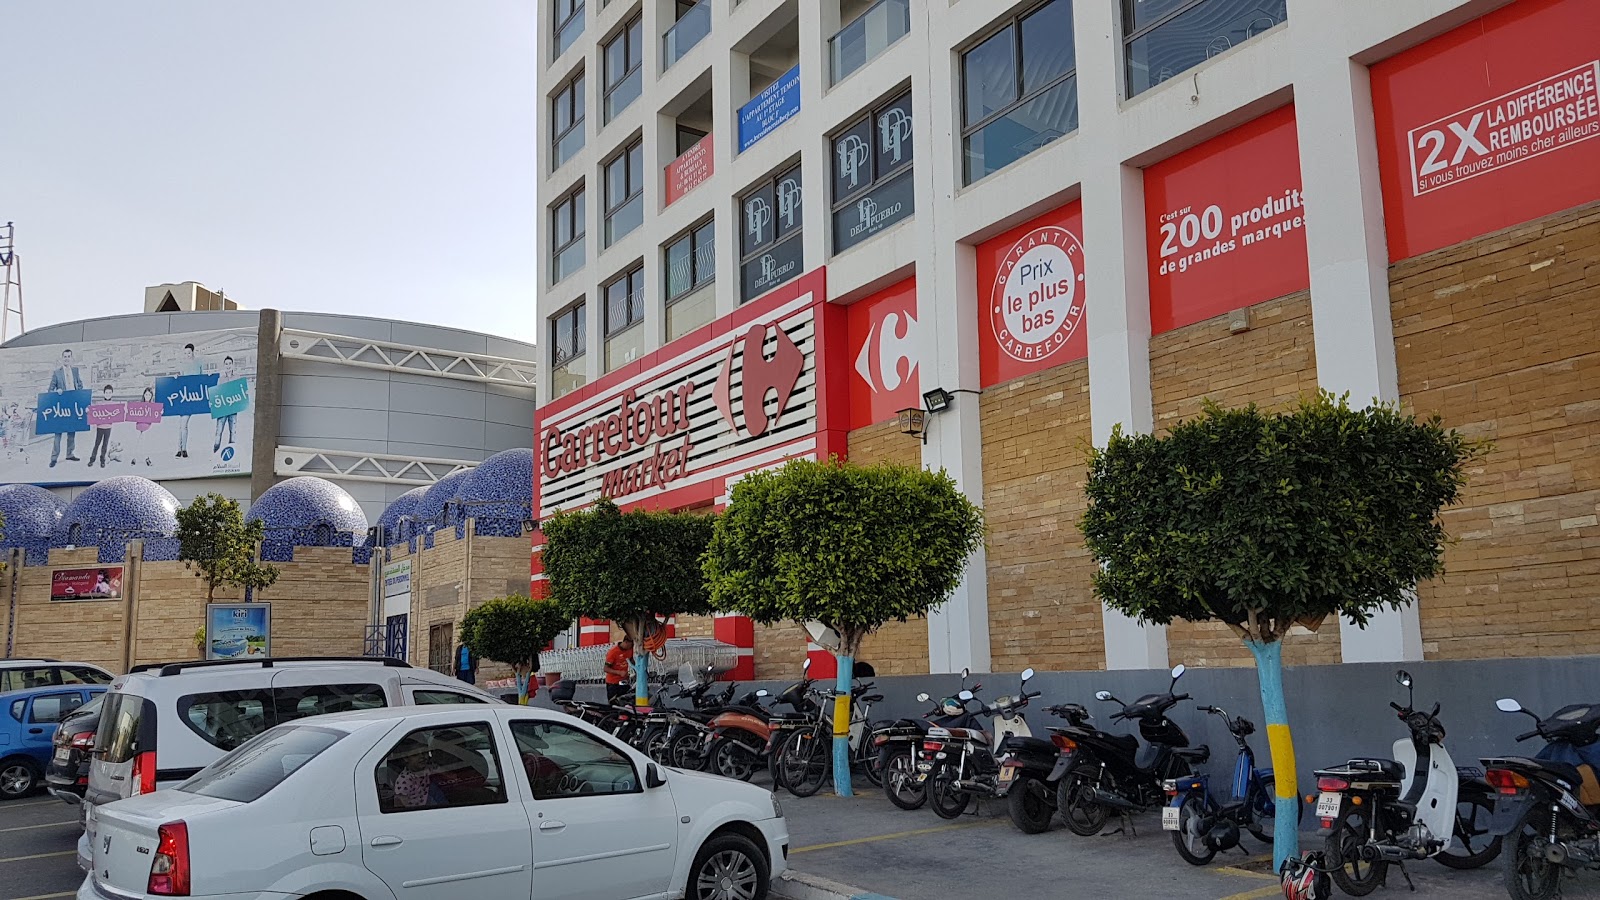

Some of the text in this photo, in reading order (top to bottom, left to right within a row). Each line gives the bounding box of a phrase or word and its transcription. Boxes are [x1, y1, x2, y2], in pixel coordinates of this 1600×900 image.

[742, 75, 800, 124] L'APPARTEMENT TEMOIN
[760, 81, 780, 100] VISITEZ
[769, 96, 785, 114] ETAGE
[1487, 69, 1594, 128] LA DIFFÉRENCE
[761, 113, 775, 128] BLOC
[1489, 95, 1598, 152] REMBOURSÉE
[1417, 111, 1490, 177] 2X
[1419, 121, 1599, 190] si vous trouvez moins cher ailleurs
[850, 202, 902, 237] DEL PUEBLO
[1159, 205, 1192, 223] C'est sur
[1160, 204, 1223, 258] 200
[754, 260, 795, 289] DEL PUEBLO
[998, 232, 1077, 285] GARANTIE
[1020, 258, 1054, 286] Prix
[1159, 260, 1176, 275] de
[1178, 239, 1236, 272] grandes
[1008, 279, 1069, 315] le plus
[999, 305, 1080, 358] CARREFOUR
[1022, 309, 1055, 333] bas
[42, 402, 84, 421] يا سلام
[167, 384, 209, 406] السلام
[214, 383, 247, 408] أسواق
[92, 408, 121, 420] عجيبة
[543, 381, 695, 479] Carrefour
[601, 433, 695, 499] market
[232, 609, 248, 618] kiri
